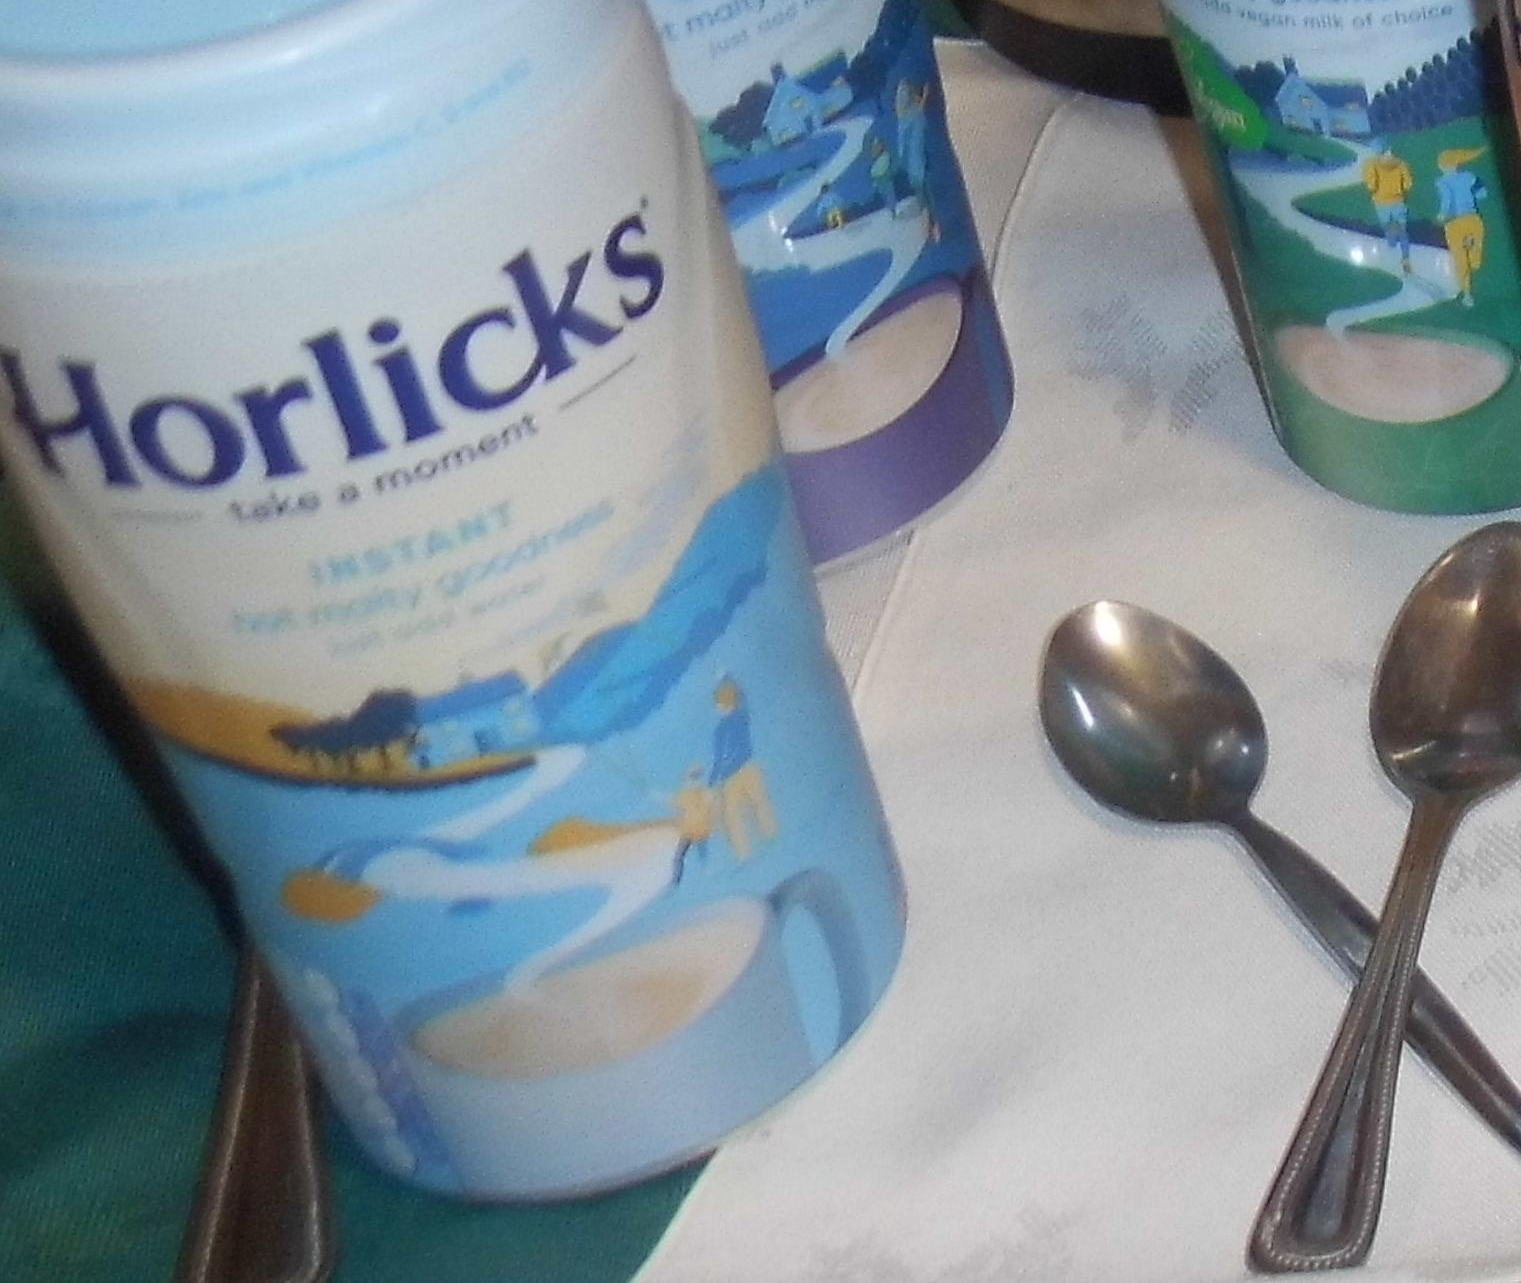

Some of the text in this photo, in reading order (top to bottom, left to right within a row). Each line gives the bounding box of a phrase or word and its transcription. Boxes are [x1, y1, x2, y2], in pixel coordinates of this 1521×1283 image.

[0, 212, 666, 489] Horlicks
[228, 413, 541, 524] take a moment
[309, 500, 513, 586] INSTANT
